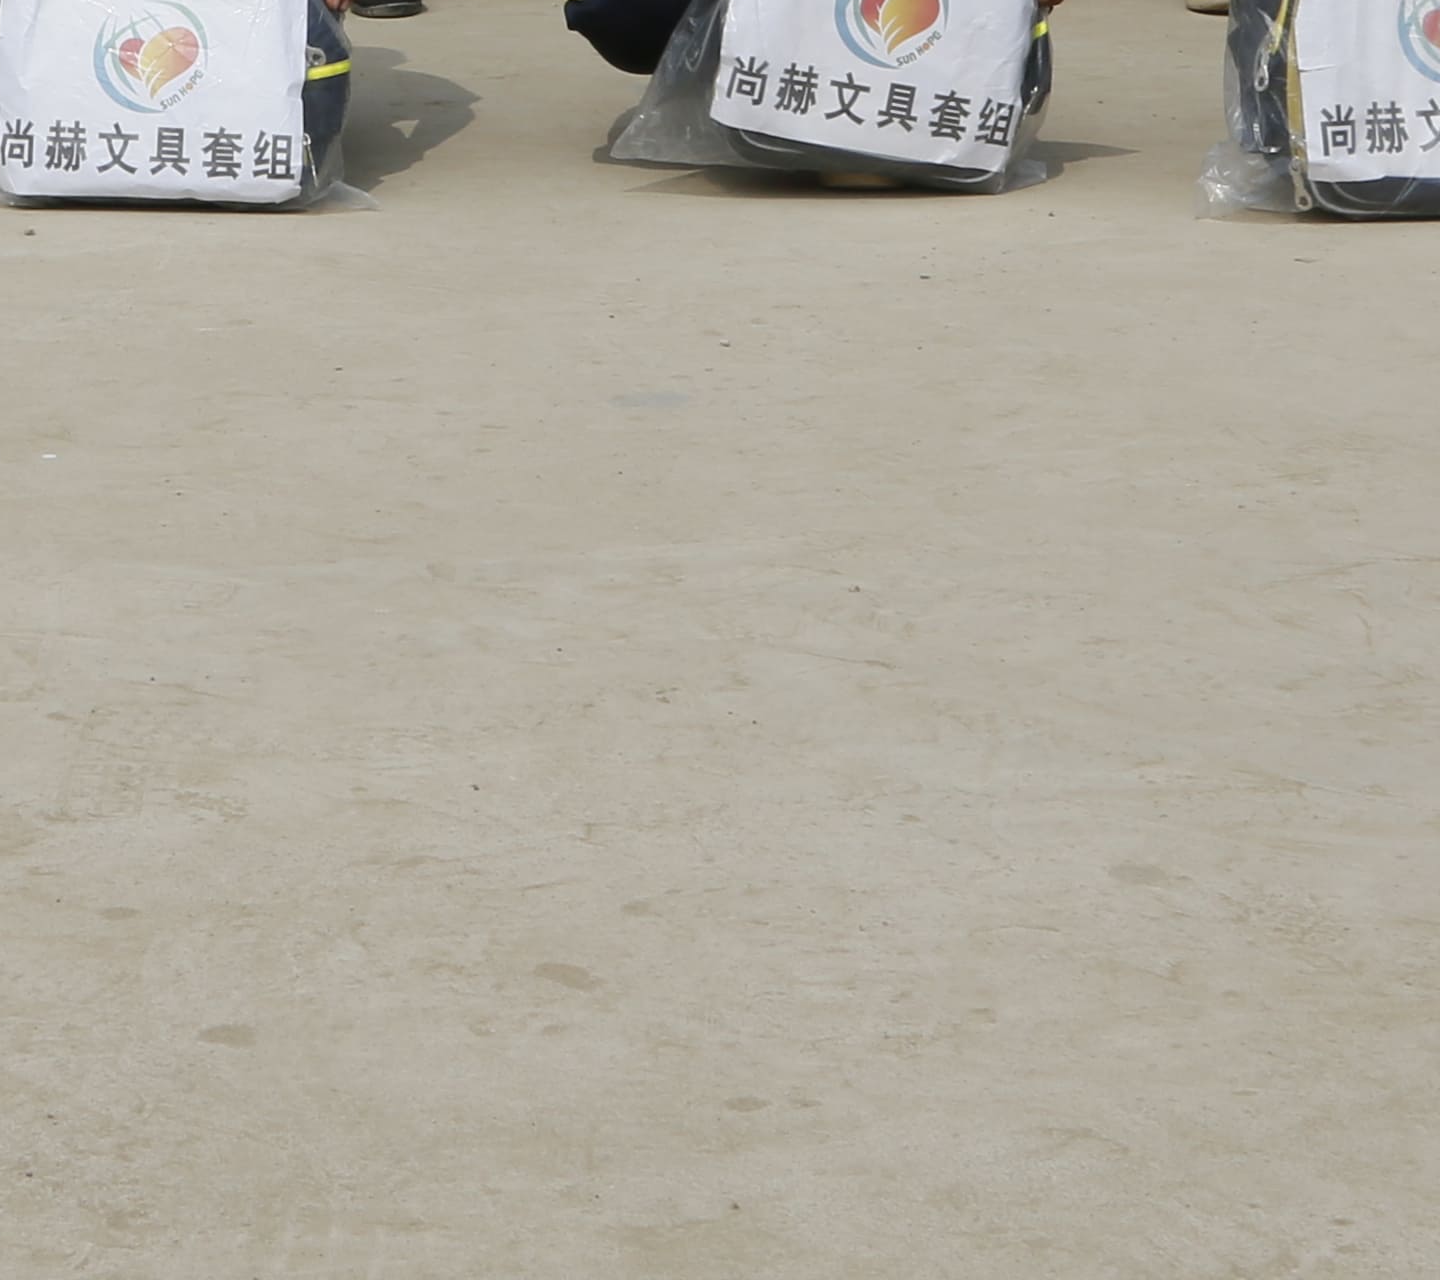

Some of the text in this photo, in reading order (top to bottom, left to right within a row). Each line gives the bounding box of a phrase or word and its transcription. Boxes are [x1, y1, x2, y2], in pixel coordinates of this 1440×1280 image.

[726, 56, 1016, 147] 尚赫文具套组
[0, 118, 297, 180] 尚赫文具套组
